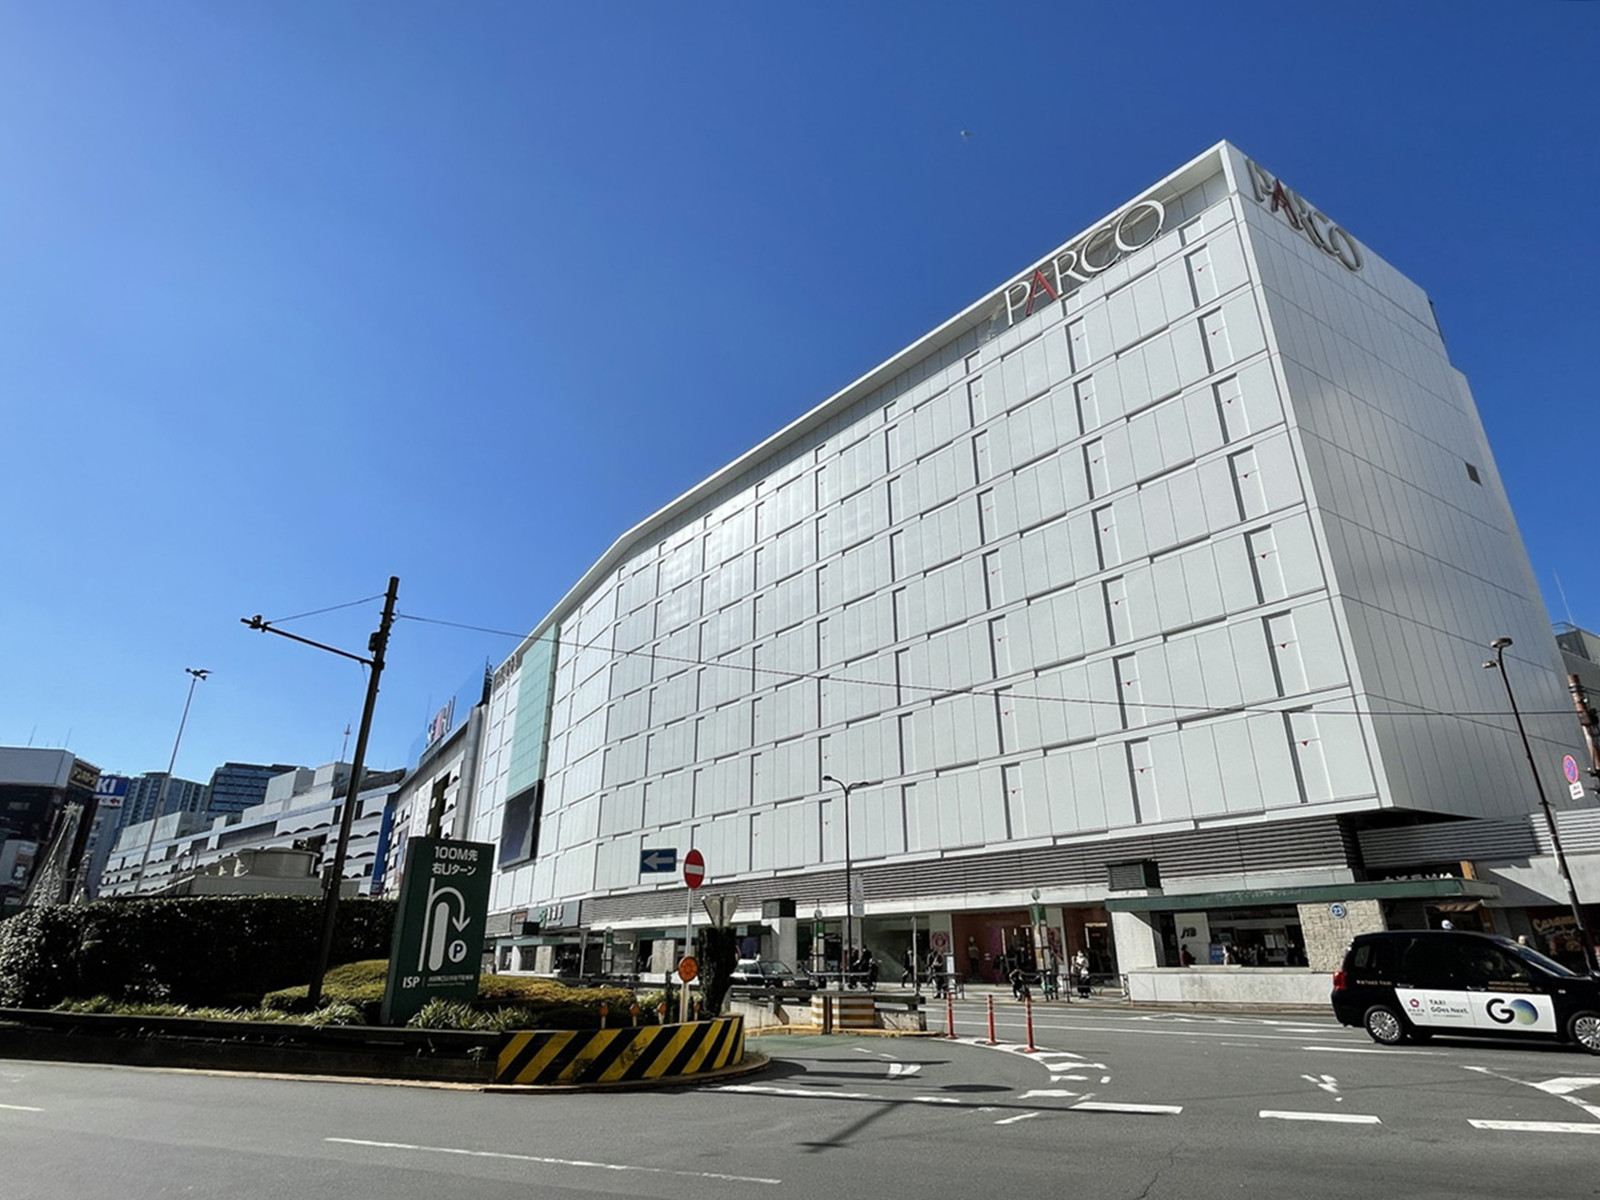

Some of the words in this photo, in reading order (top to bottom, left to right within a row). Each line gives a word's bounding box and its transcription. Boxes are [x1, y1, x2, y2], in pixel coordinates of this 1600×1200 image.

[1246, 158, 1363, 272] PARCO
[1003, 200, 1165, 326] PARCO
[434, 846, 478, 861] 100M先
[432, 863, 476, 876] 右Uターン
[453, 943, 464, 959] P
[402, 976, 421, 989] ISP
[1486, 998, 1539, 1026] GO
